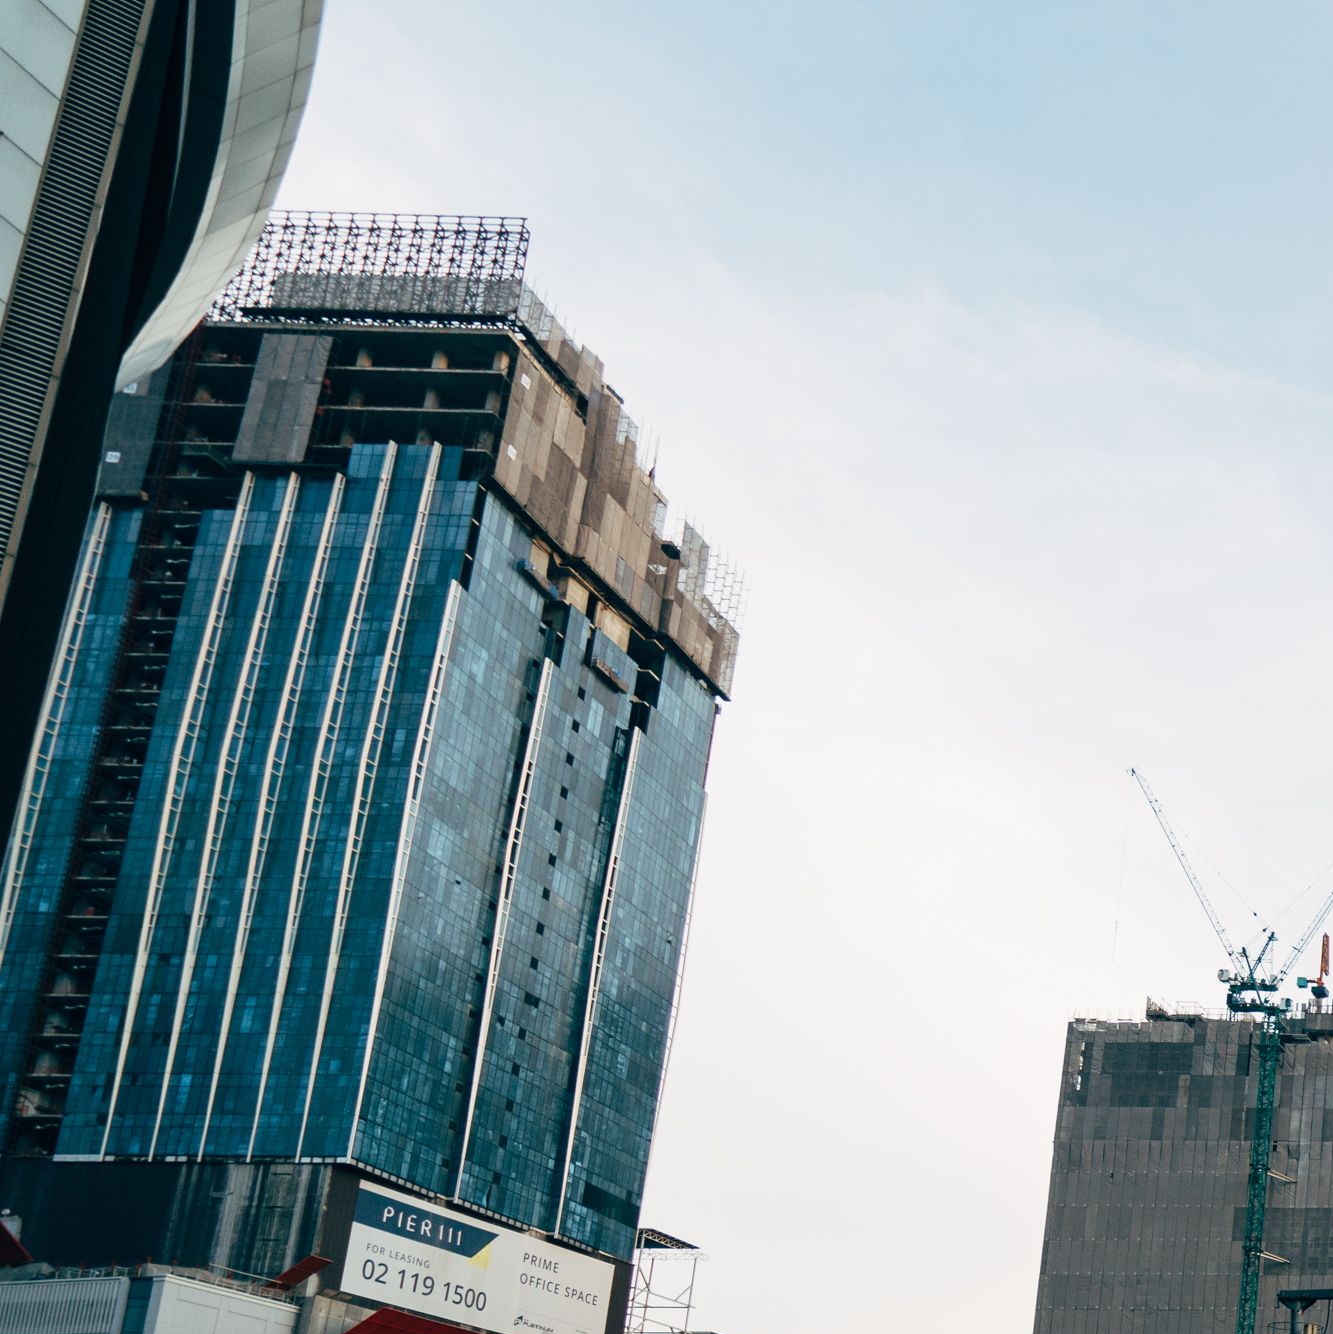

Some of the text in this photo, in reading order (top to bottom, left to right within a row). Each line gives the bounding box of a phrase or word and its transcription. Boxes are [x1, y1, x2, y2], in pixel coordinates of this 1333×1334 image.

[366, 1243, 430, 1269] FOR LEASING
[523, 1252, 559, 1273] PRIME
[362, 1258, 487, 1311] 02 119 1500
[520, 1273, 598, 1306] OFFICE SPACE
